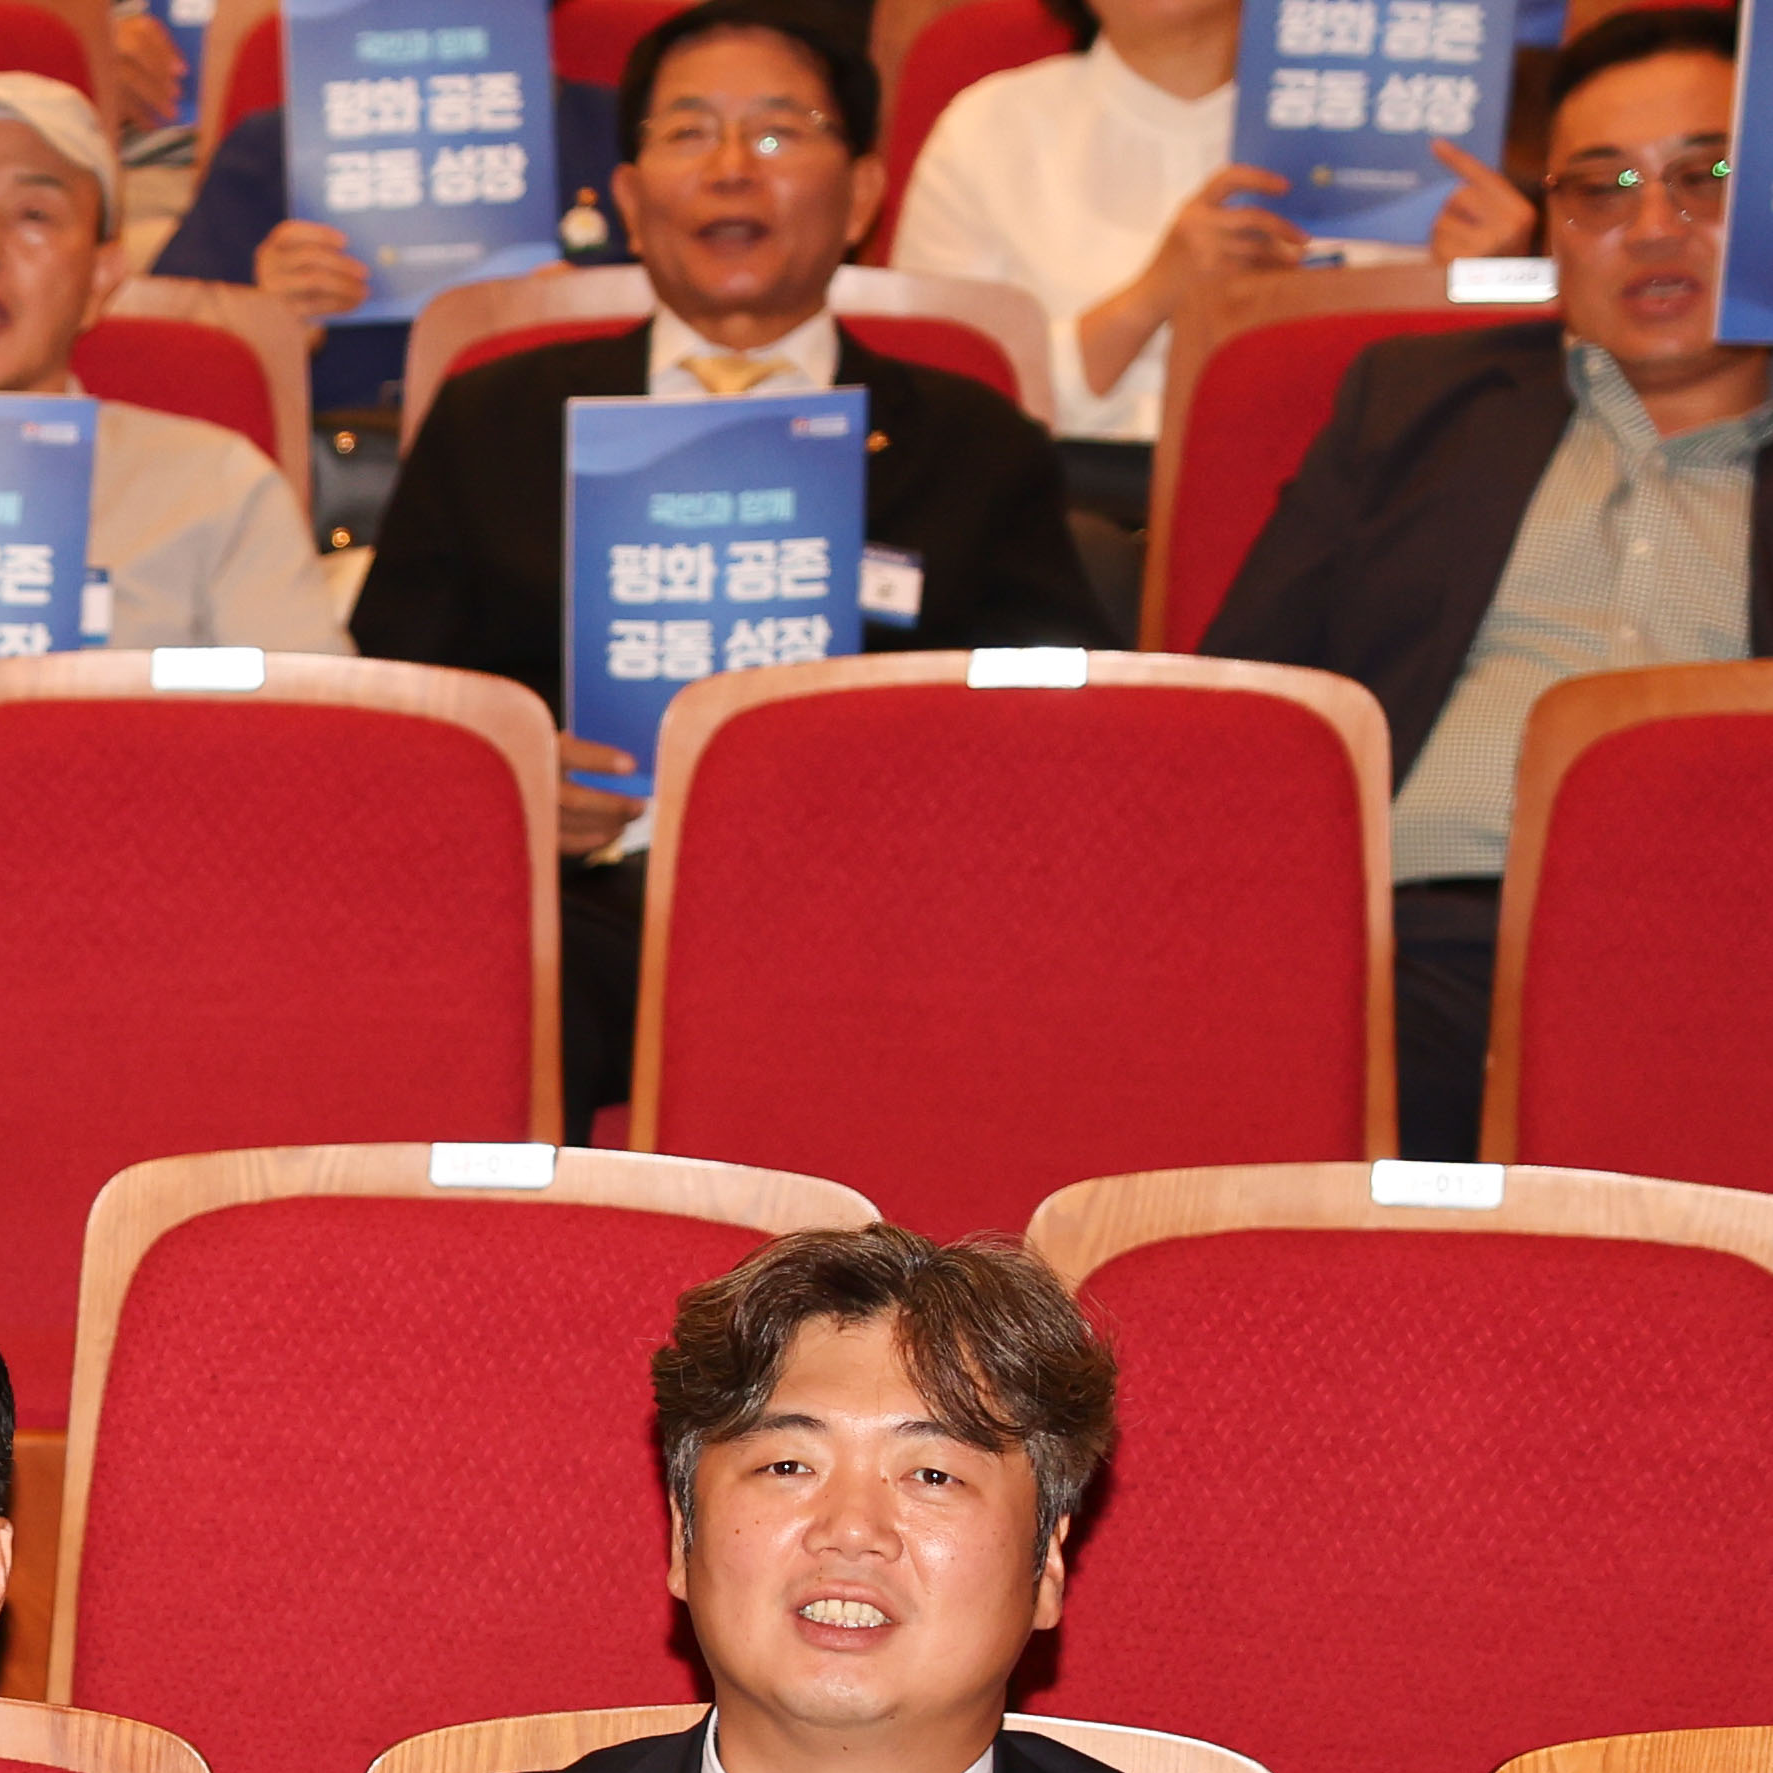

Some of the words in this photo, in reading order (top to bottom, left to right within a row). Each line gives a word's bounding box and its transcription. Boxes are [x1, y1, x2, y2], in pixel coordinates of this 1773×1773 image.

[611, 544, 717, 602] 평화
[726, 539, 829, 601] 공존
[610, 621, 716, 681] 공동
